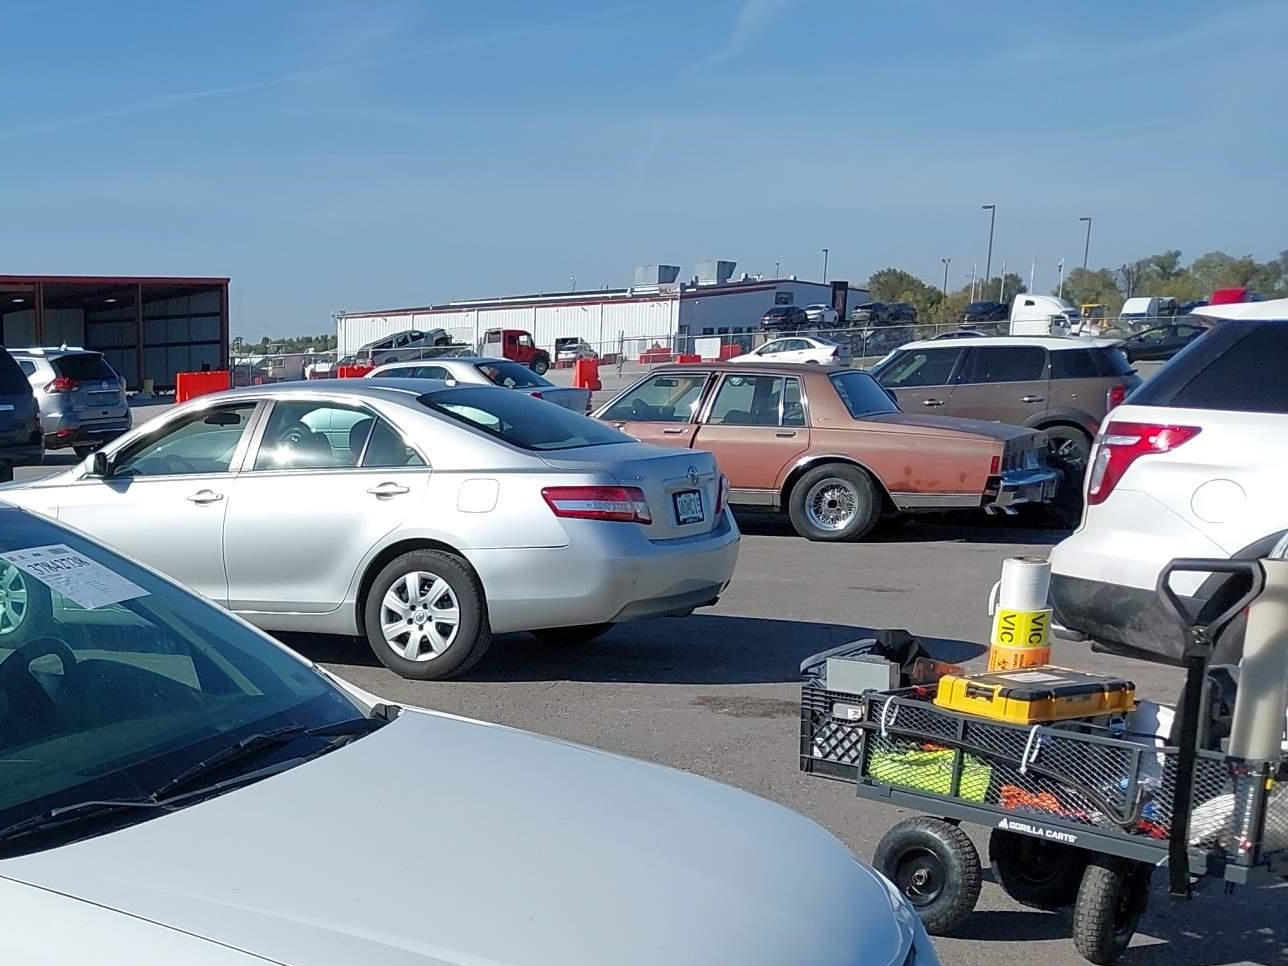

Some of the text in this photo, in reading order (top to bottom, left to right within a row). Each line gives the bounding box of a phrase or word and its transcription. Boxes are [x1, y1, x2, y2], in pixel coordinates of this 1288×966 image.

[1000, 613, 1017, 644] VIC
[1028, 614, 1046, 645] VIC
[1008, 821, 1075, 843] GORILLA CARTS
